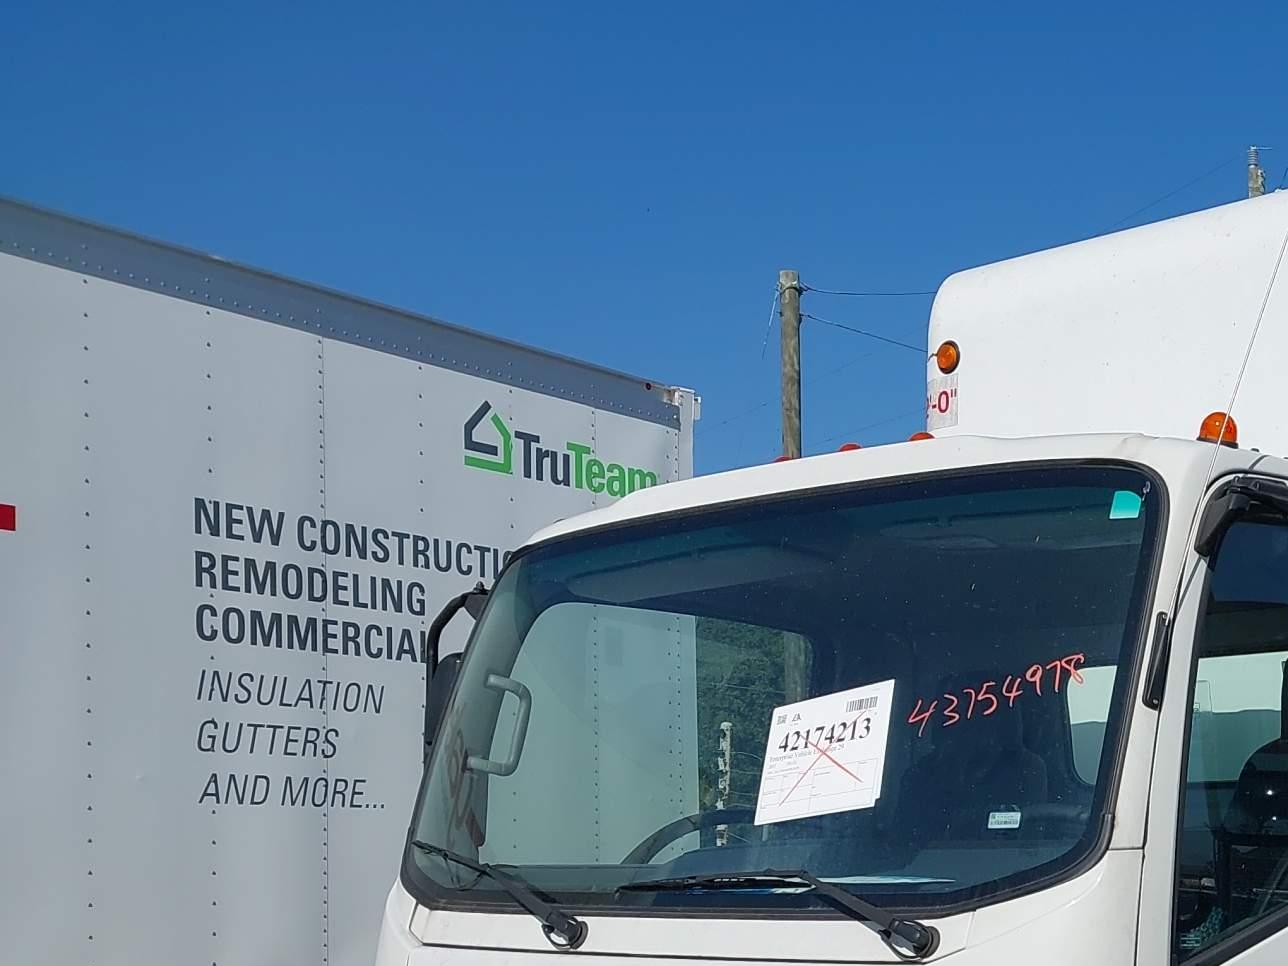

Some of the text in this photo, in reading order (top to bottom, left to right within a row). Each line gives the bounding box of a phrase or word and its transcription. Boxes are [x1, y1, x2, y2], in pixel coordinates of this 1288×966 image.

[514, 430, 657, 497] TruTeam
[193, 497, 286, 546] NEW
[193, 550, 427, 617] REMODELING
[196, 603, 428, 663] COMMERCIAL
[197, 669, 384, 714] INSULATION
[907, 653, 1086, 738] 43754978
[197, 720, 340, 759] GUTTERS
[778, 717, 872, 753] 42174213
[198, 773, 386, 810] AND MORE...
